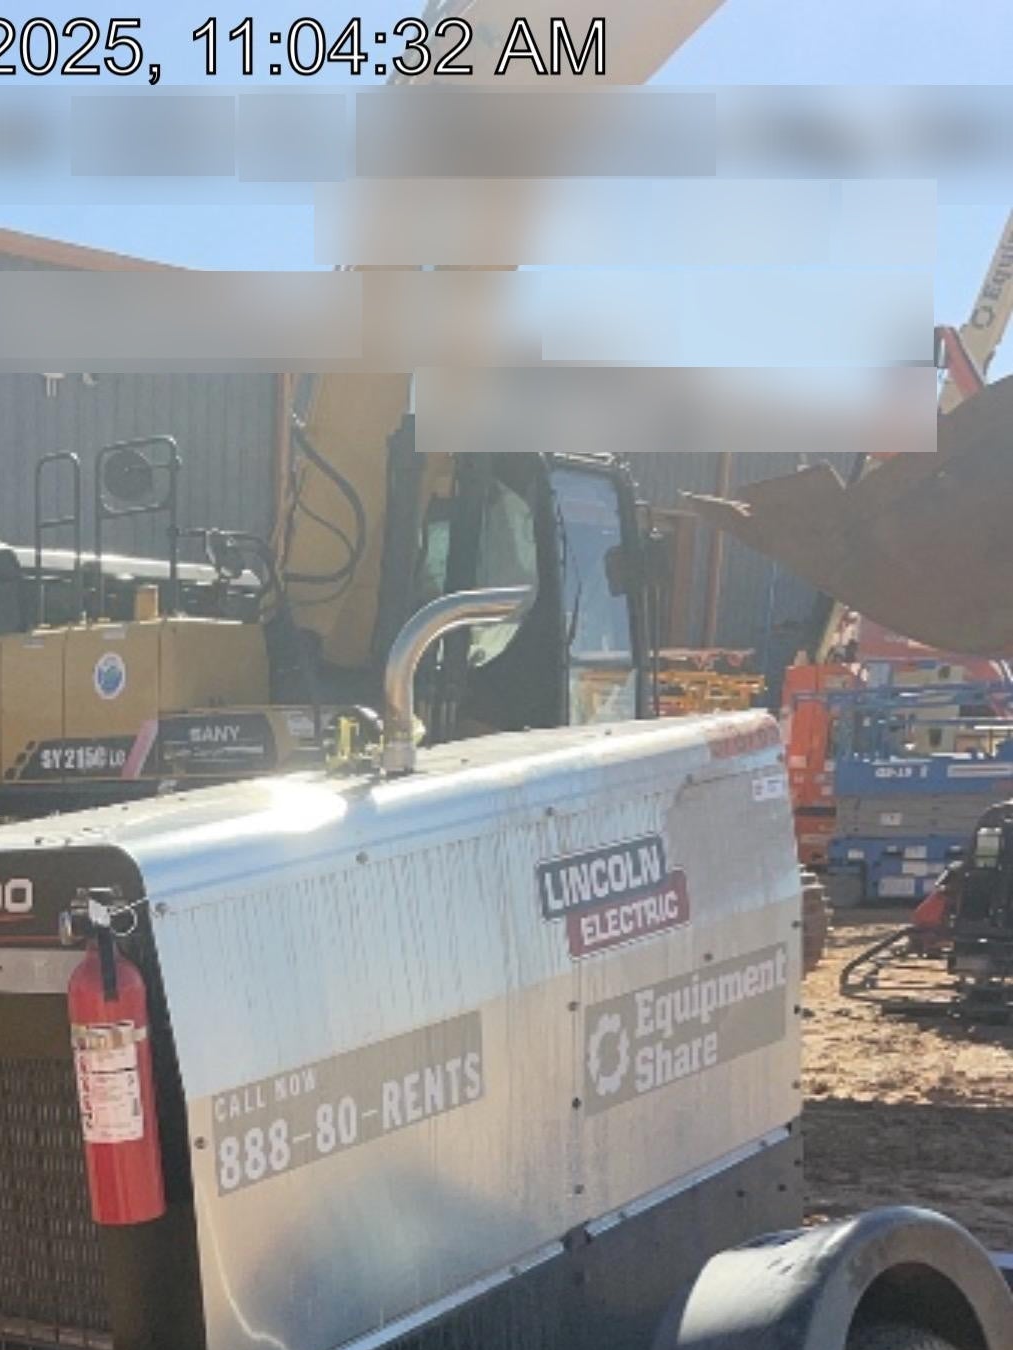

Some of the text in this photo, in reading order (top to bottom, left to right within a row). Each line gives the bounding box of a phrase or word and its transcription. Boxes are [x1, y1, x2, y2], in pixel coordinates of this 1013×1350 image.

[191, 726, 240, 743] SANY
[544, 845, 662, 911] LINCOLN
[580, 891, 679, 946] ELECTRIC
[635, 948, 787, 1038] Equipment
[635, 1032, 718, 1093] Share
[214, 1068, 317, 1122] CALL NOW
[219, 1052, 482, 1189] 888-80-RENTS
